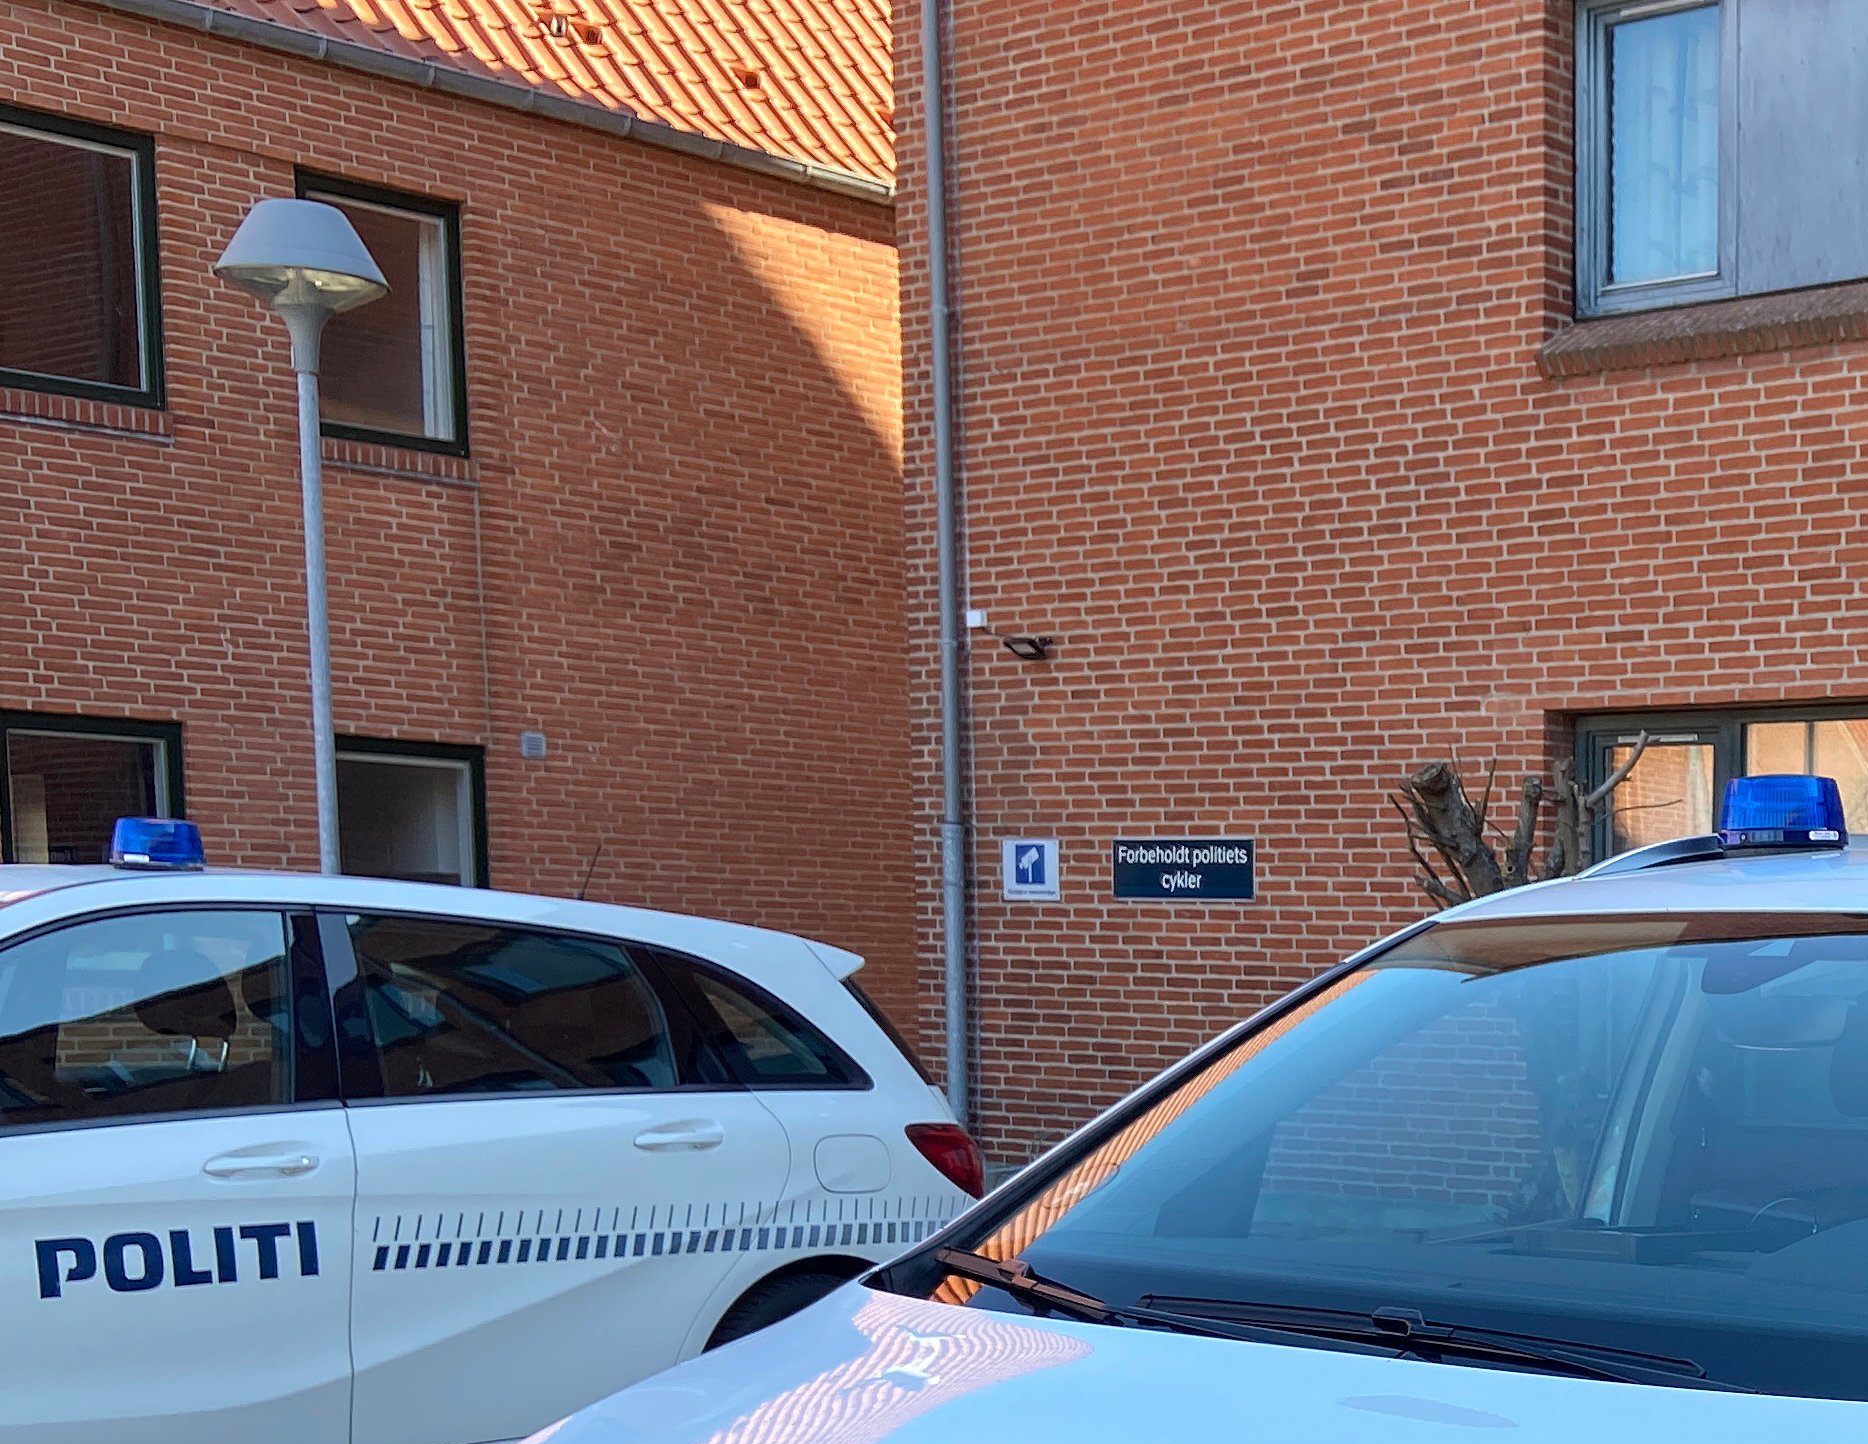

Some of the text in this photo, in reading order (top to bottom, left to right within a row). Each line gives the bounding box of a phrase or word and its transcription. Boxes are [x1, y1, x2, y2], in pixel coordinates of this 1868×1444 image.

[1117, 844, 1249, 869] Forbeholdt politiets
[1162, 869, 1203, 893] cykler
[35, 1221, 319, 1299] POLITI
